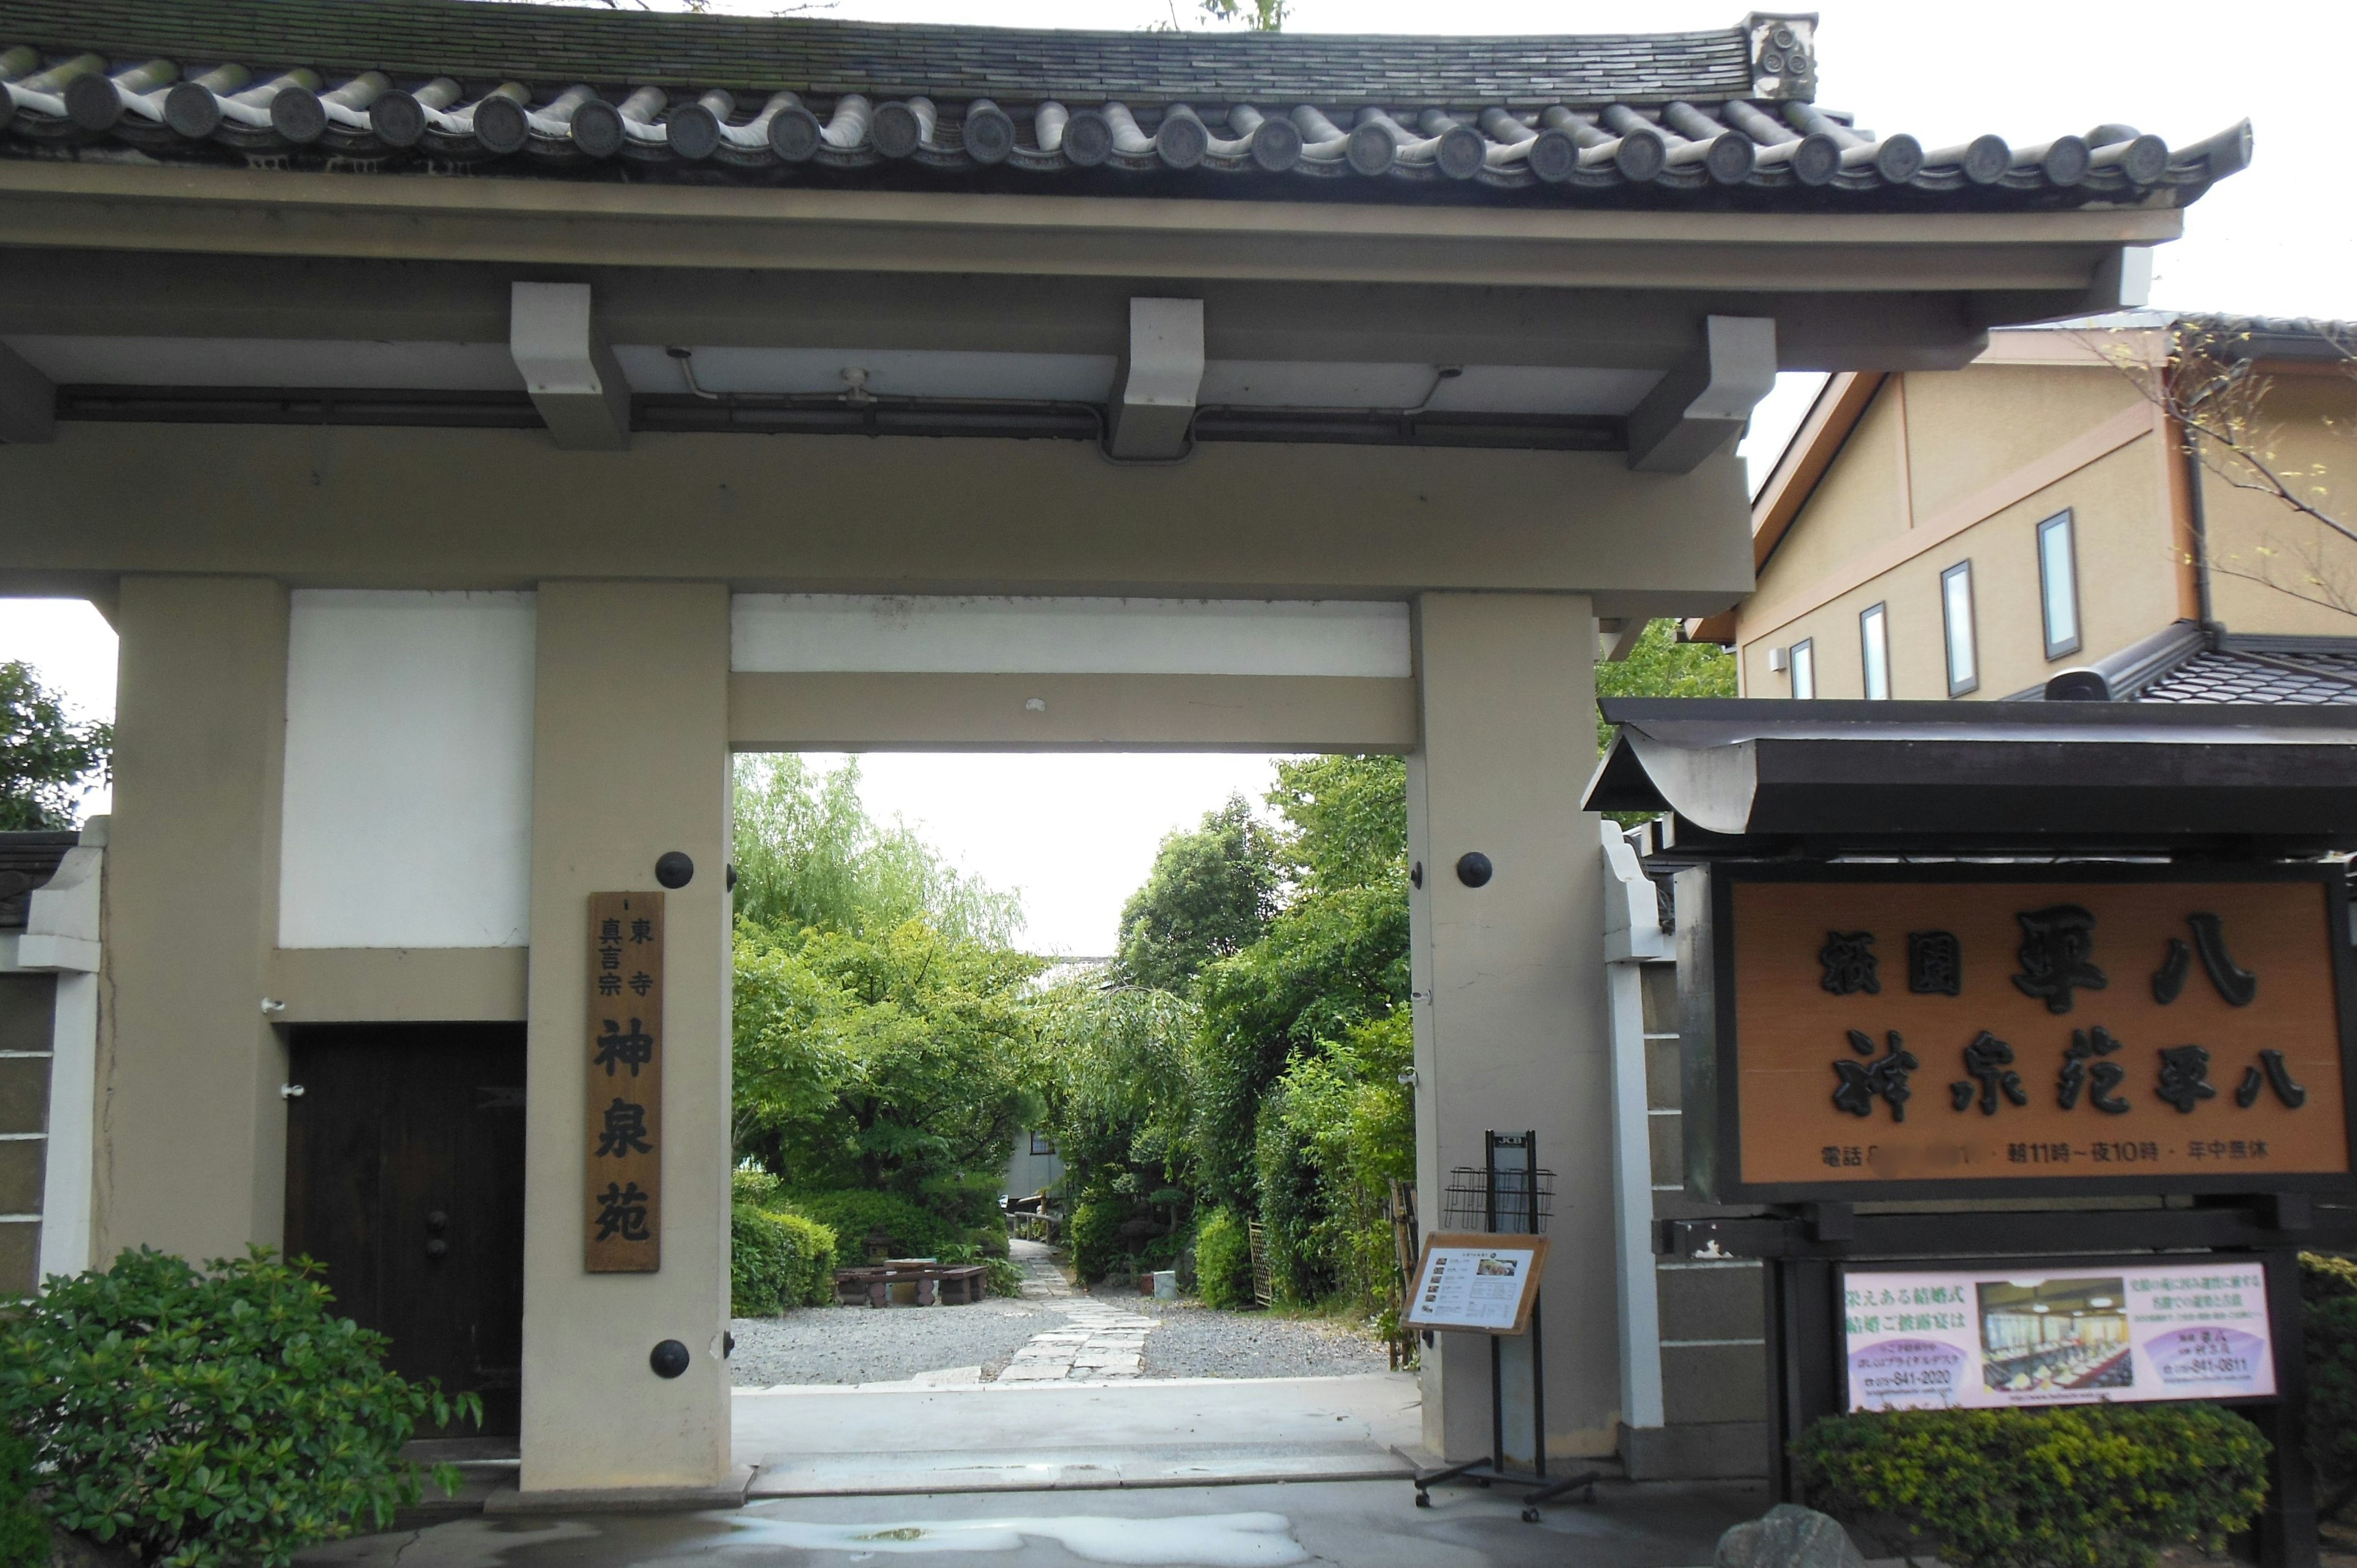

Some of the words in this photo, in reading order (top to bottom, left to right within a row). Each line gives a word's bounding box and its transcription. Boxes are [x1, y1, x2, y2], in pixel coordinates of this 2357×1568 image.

[628, 918, 654, 997] 東寺
[592, 1018, 654, 1243] 神泉苑
